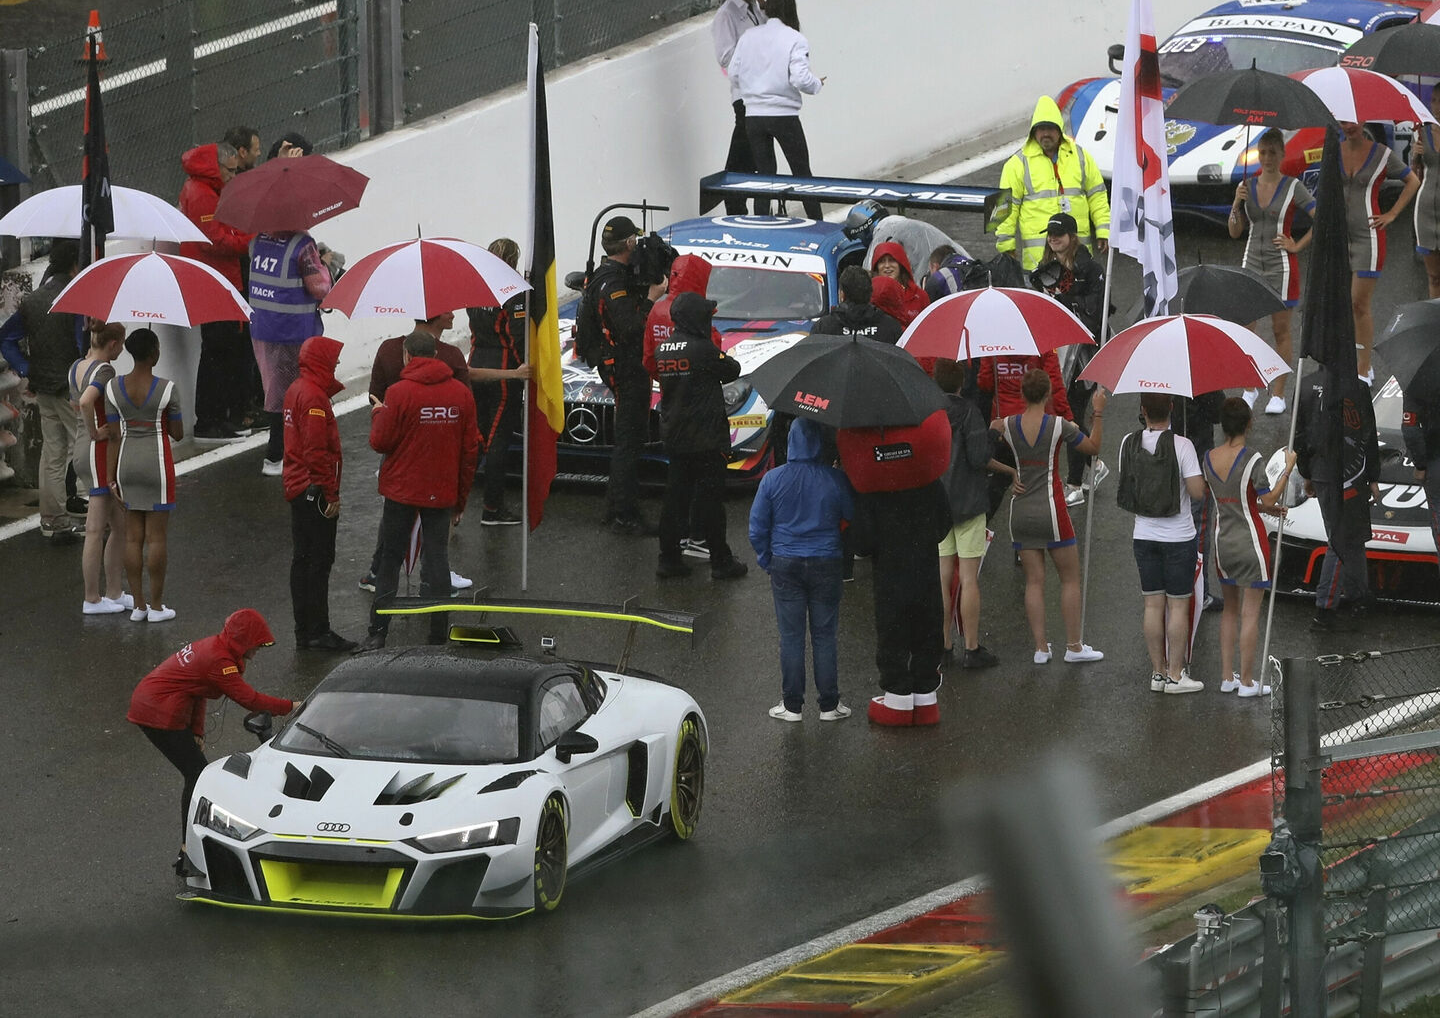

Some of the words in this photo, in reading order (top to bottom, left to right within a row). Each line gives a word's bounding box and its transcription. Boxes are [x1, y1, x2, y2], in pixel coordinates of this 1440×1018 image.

[1208, 17, 1341, 38] BLANCPAIN
[1340, 55, 1375, 67] SRO
[1246, 115, 1263, 123] AM
[317, 200, 344, 216] DUNLOP
[254, 255, 278, 273] 147
[690, 251, 792, 269] NCPAIN
[251, 286, 275, 299] TRACK
[499, 284, 517, 295] TOTAL
[130, 310, 167, 320] TOTAL
[374, 306, 407, 314] TOTAL
[659, 342, 688, 352] STAFF
[979, 345, 1015, 353] TOTAL
[657, 358, 690, 374] SRO
[1264, 365, 1280, 375] TOTAL
[1138, 380, 1171, 389] TOTAL
[795, 391, 830, 411] LEM
[419, 406, 461, 420] SRO
